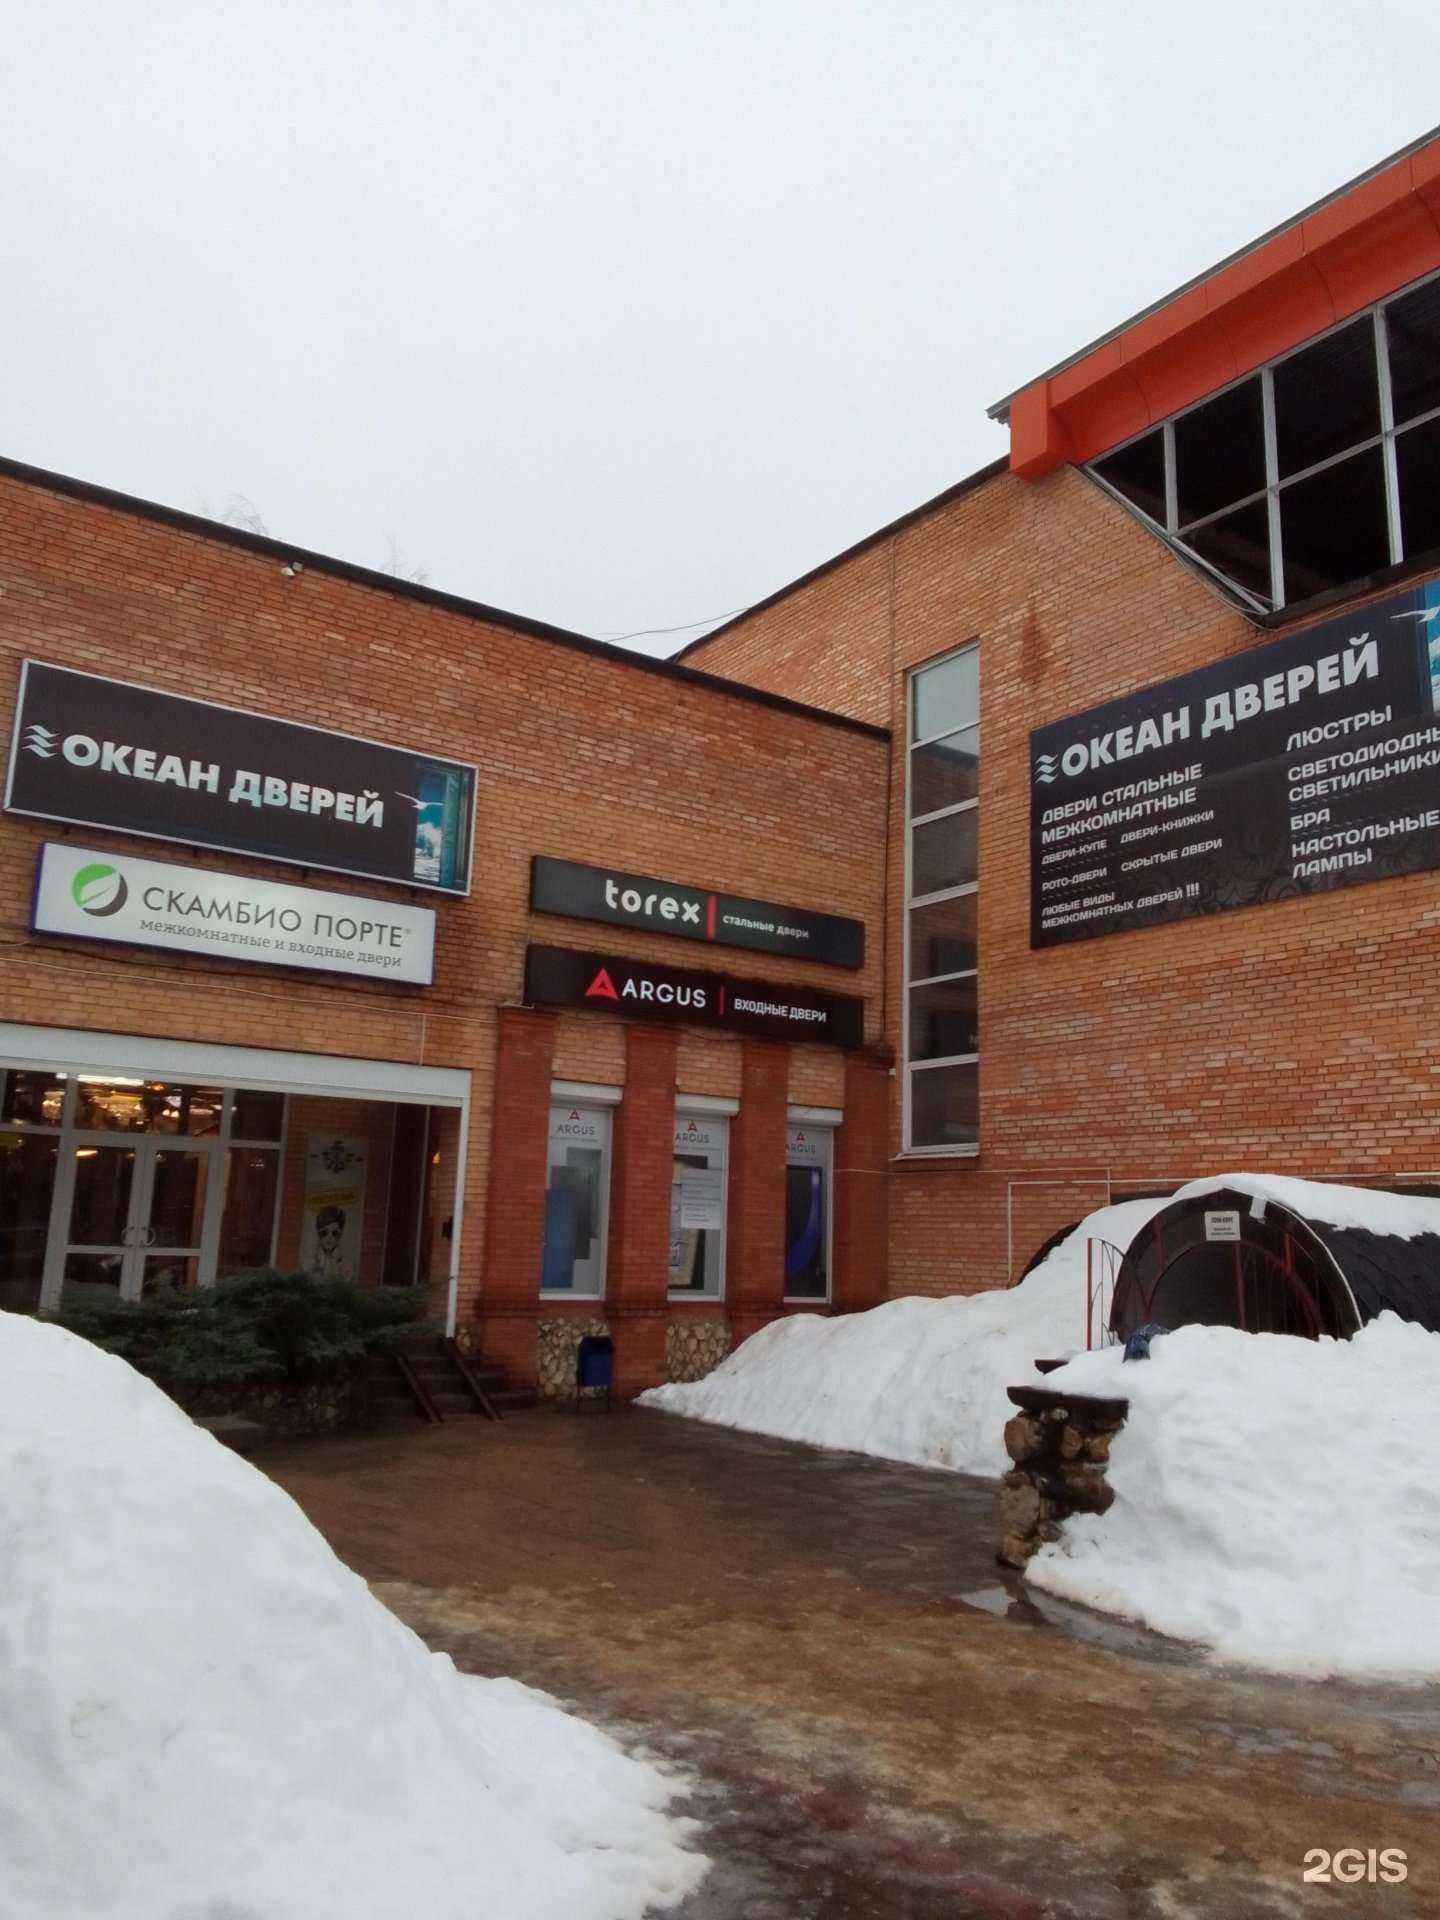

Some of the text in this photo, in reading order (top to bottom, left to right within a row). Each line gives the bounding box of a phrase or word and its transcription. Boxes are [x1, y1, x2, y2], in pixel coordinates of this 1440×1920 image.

[1061, 633, 1378, 777] ОКЕАН ДВЕРЕЙ
[1287, 705, 1392, 751] ЛЮСТРЫ
[62, 734, 384, 828] ОКЕАН ДВЕРЕЙ
[1041, 763, 1202, 825] ДВЕРИ СТАЛЬНЫЕ
[1042, 787, 1197, 844] МЕЖКОМНАТНЫЕ
[1120, 810, 1214, 843] ДВЕРИ-КНИЖКИ
[1291, 808, 1330, 830] БРА
[1292, 809, 1440, 857] НАСТОЛЬНЫЕ
[1041, 839, 1107, 864] ДВЕРИ-КУПЕ
[1121, 838, 1222, 871] СКРЫТЫЕ ДВЕРИ
[1293, 848, 1372, 878] ЛАМПЫ
[1042, 867, 1107, 891] РОТО-ДВЕРИ
[143, 887, 403, 948] СКАМБИО ПОРТЕ
[605, 879, 700, 925] torex
[1042, 892, 1115, 916] ЛЮБЫЕ ВИДЫ
[1042, 900, 1134, 928] МЕЖКОМНАТНЫХ
[1136, 888, 1183, 908] ДВЕРЕЙ
[140, 920, 402, 968] межкомнатные и входные двери
[723, 915, 809, 938] стальные двери
[622, 978, 706, 1008] ARGUS
[734, 998, 826, 1022] ВХОДНЫЕ ДВЕРИ
